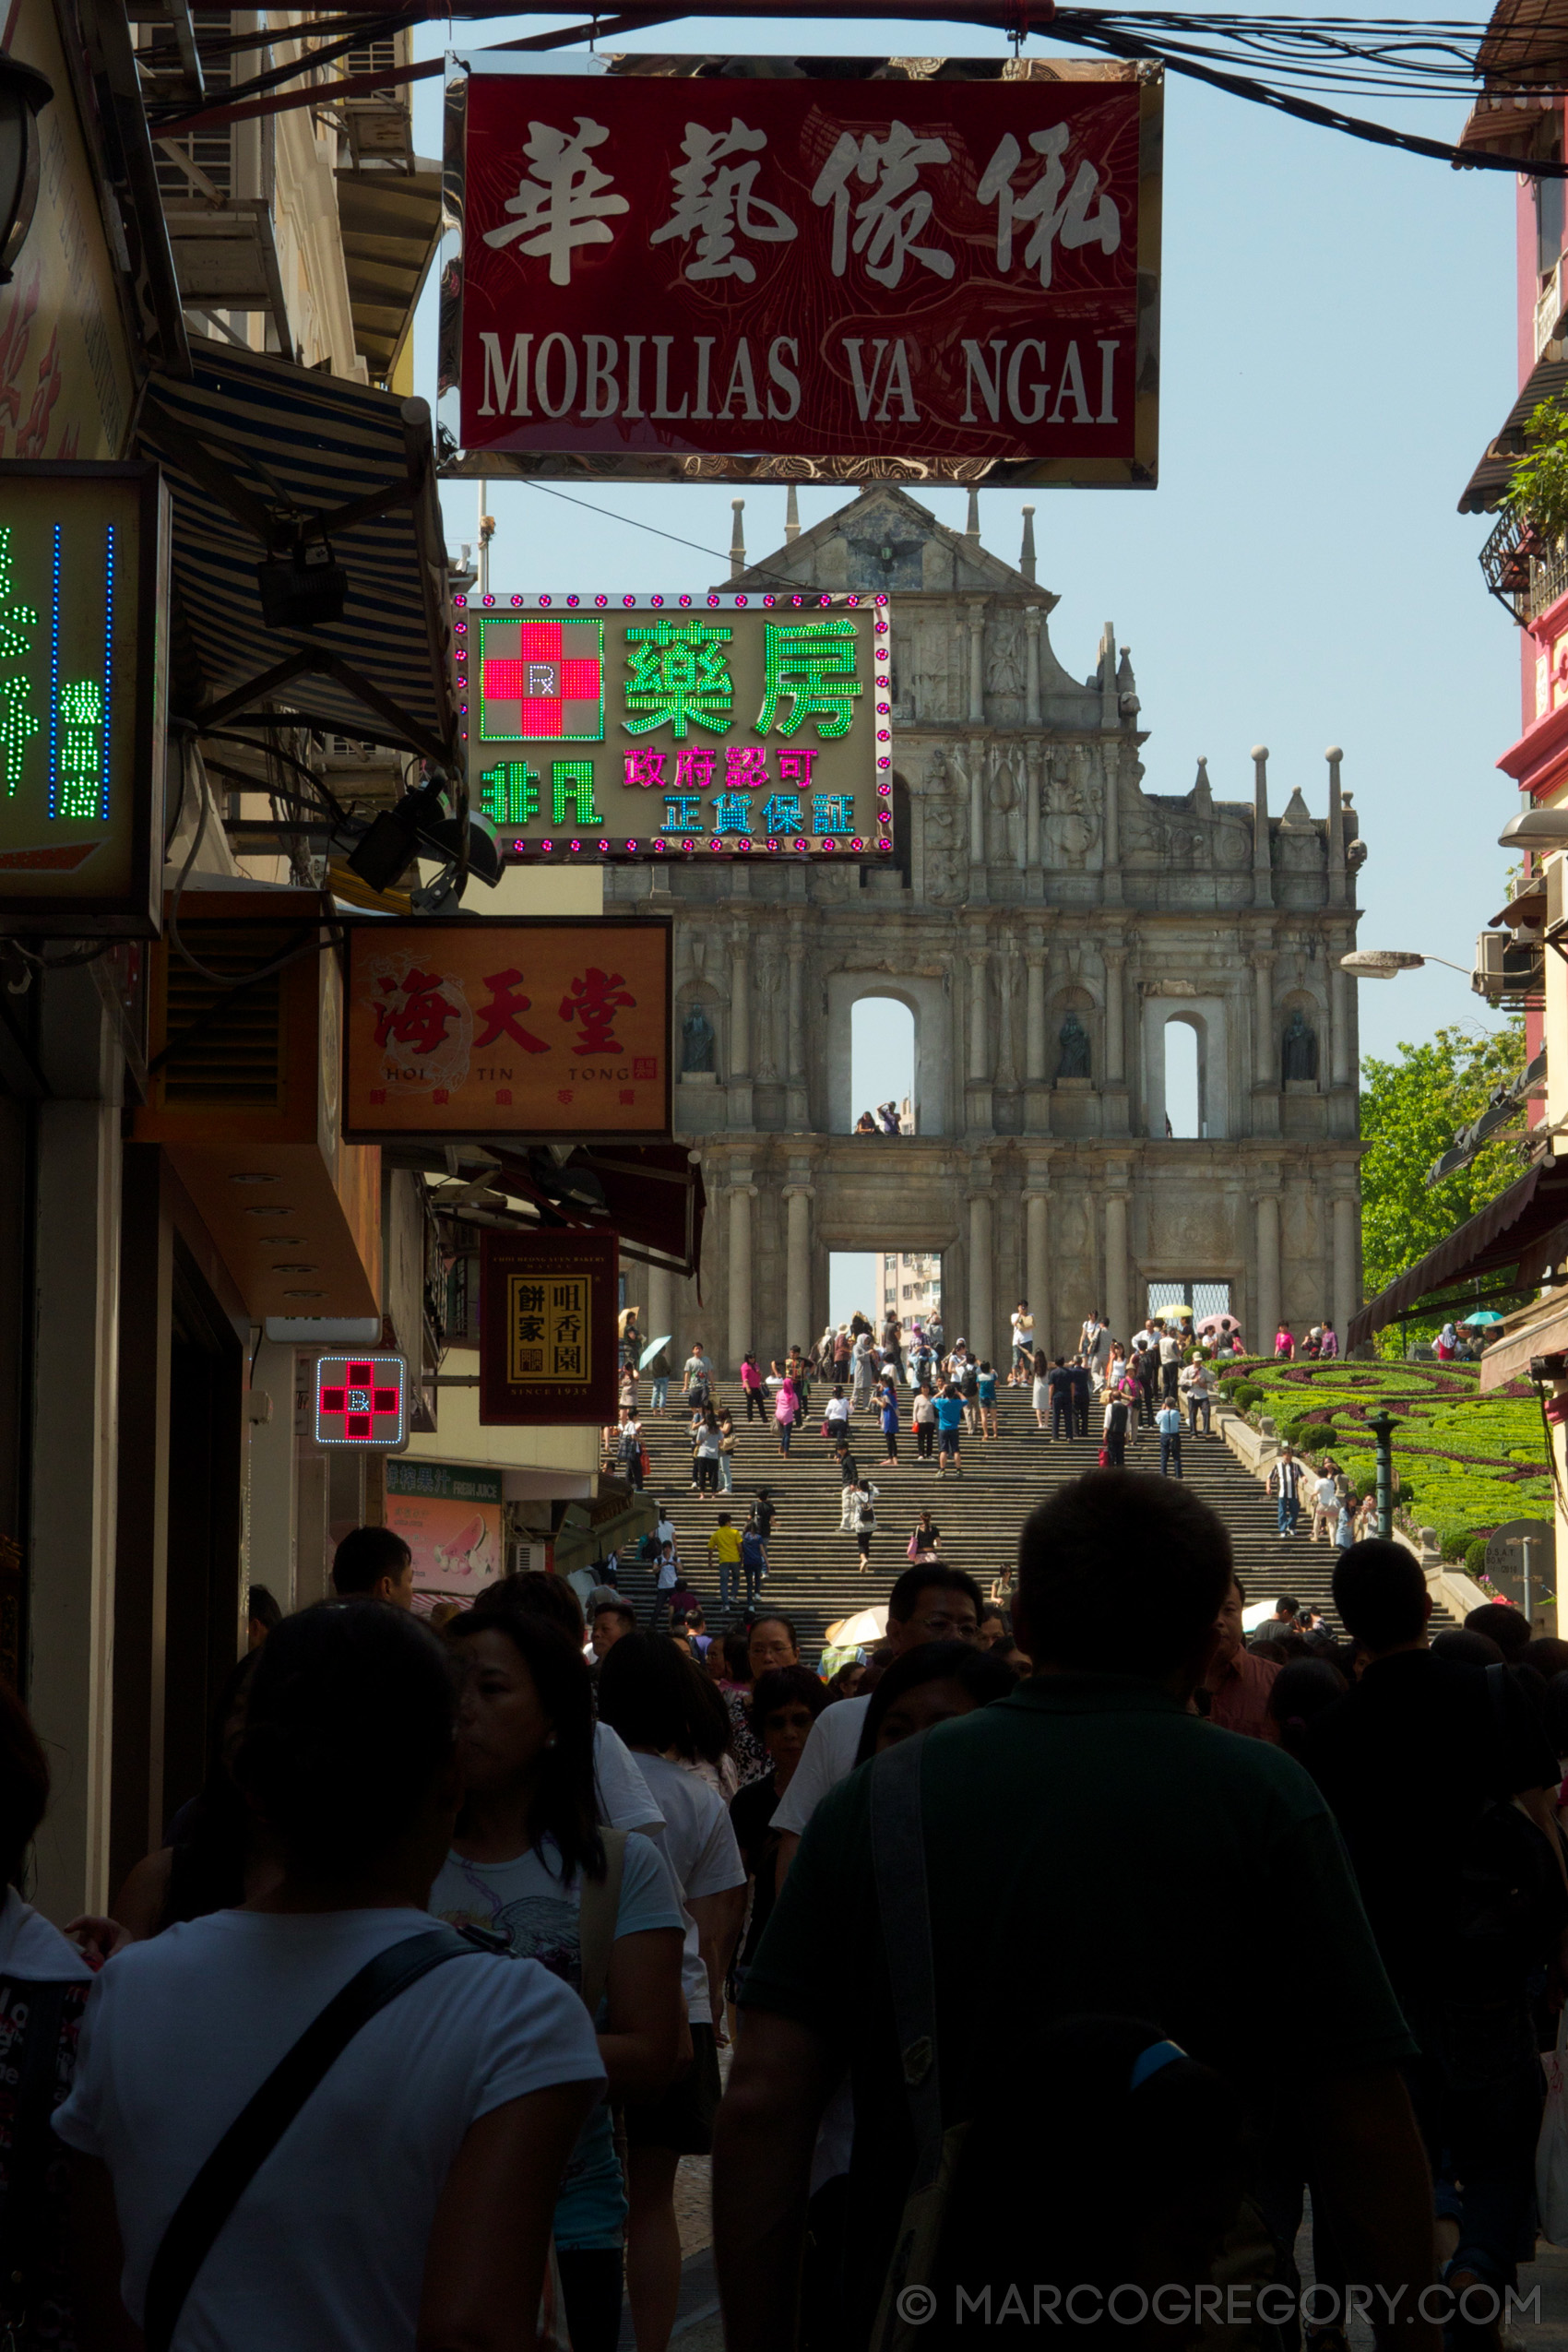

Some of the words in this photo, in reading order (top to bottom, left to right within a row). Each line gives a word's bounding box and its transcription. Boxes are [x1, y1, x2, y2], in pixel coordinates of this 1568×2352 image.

[482, 116, 1121, 289] 華藝傢俬
[478, 331, 801, 422] MOBILIAS
[841, 338, 921, 422] VA
[959, 339, 1118, 424] NGAI
[621, 619, 862, 738] 藥房
[480, 760, 604, 825] 非凡
[624, 745, 818, 788] 政府認可
[659, 792, 856, 834] 正貨保証
[373, 967, 636, 1055] 海天堂
[386, 1067, 424, 1080] HOI
[477, 1067, 513, 1080] TIN
[568, 1067, 630, 1081] TONG
[518, 1285, 545, 1342] 餅家
[553, 1284, 581, 1374] 咀香園
[510, 1387, 551, 1396] SINCE
[554, 1387, 588, 1396] 1935
[453, 1480, 476, 1495] FRESH
[476, 1483, 498, 1499] JUICE
